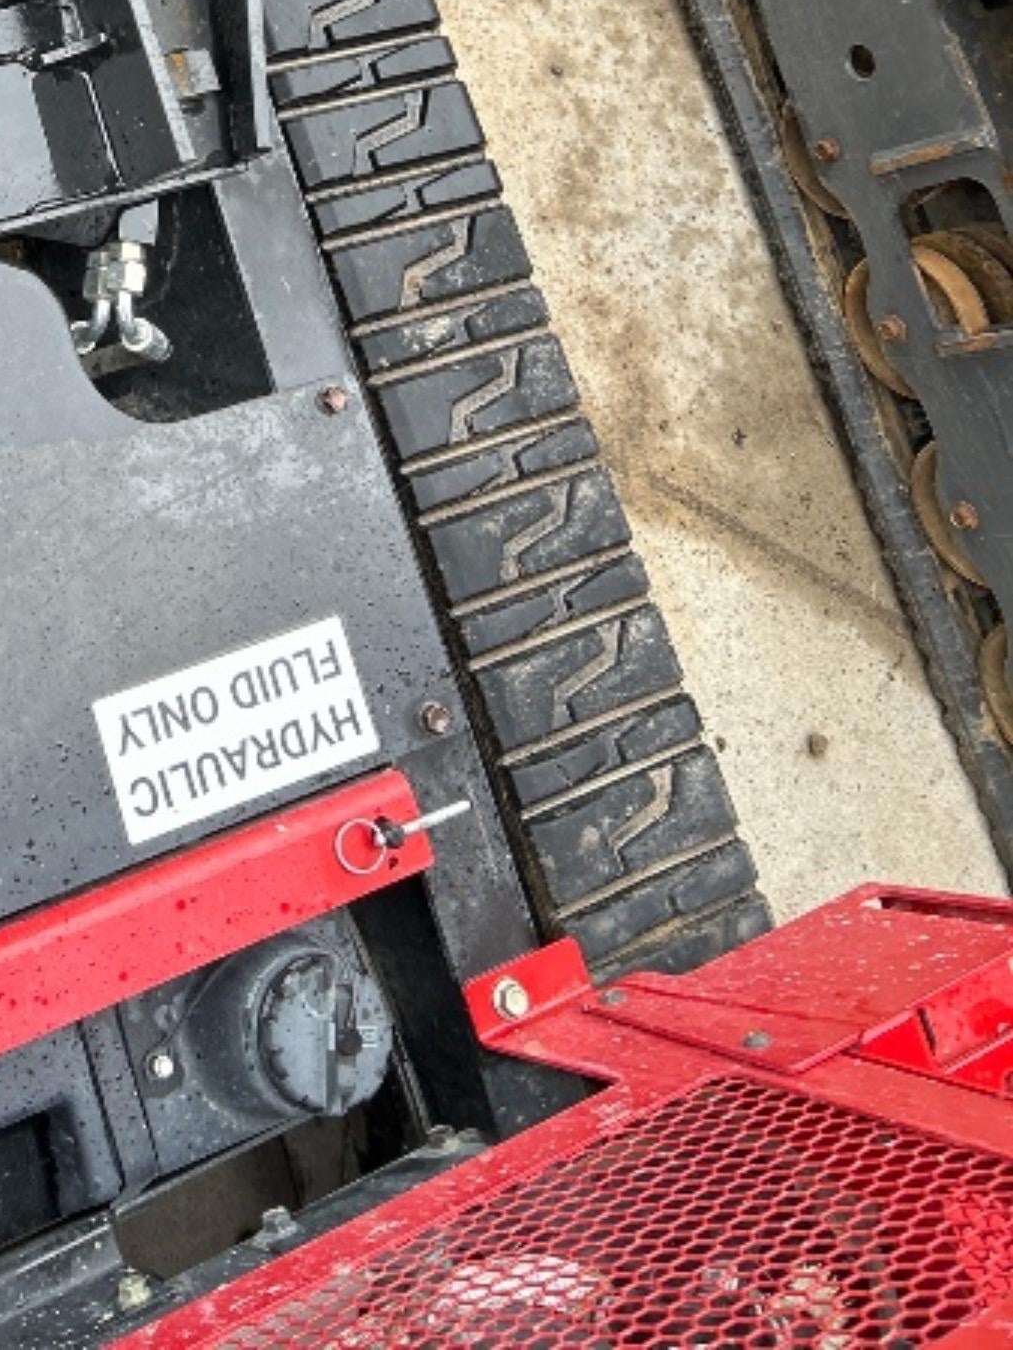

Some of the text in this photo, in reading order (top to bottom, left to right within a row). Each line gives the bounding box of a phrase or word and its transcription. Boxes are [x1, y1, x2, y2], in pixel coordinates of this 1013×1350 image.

[118, 640, 341, 756] FLUID ONLY
[129, 698, 362, 816] HYDRAULIC
